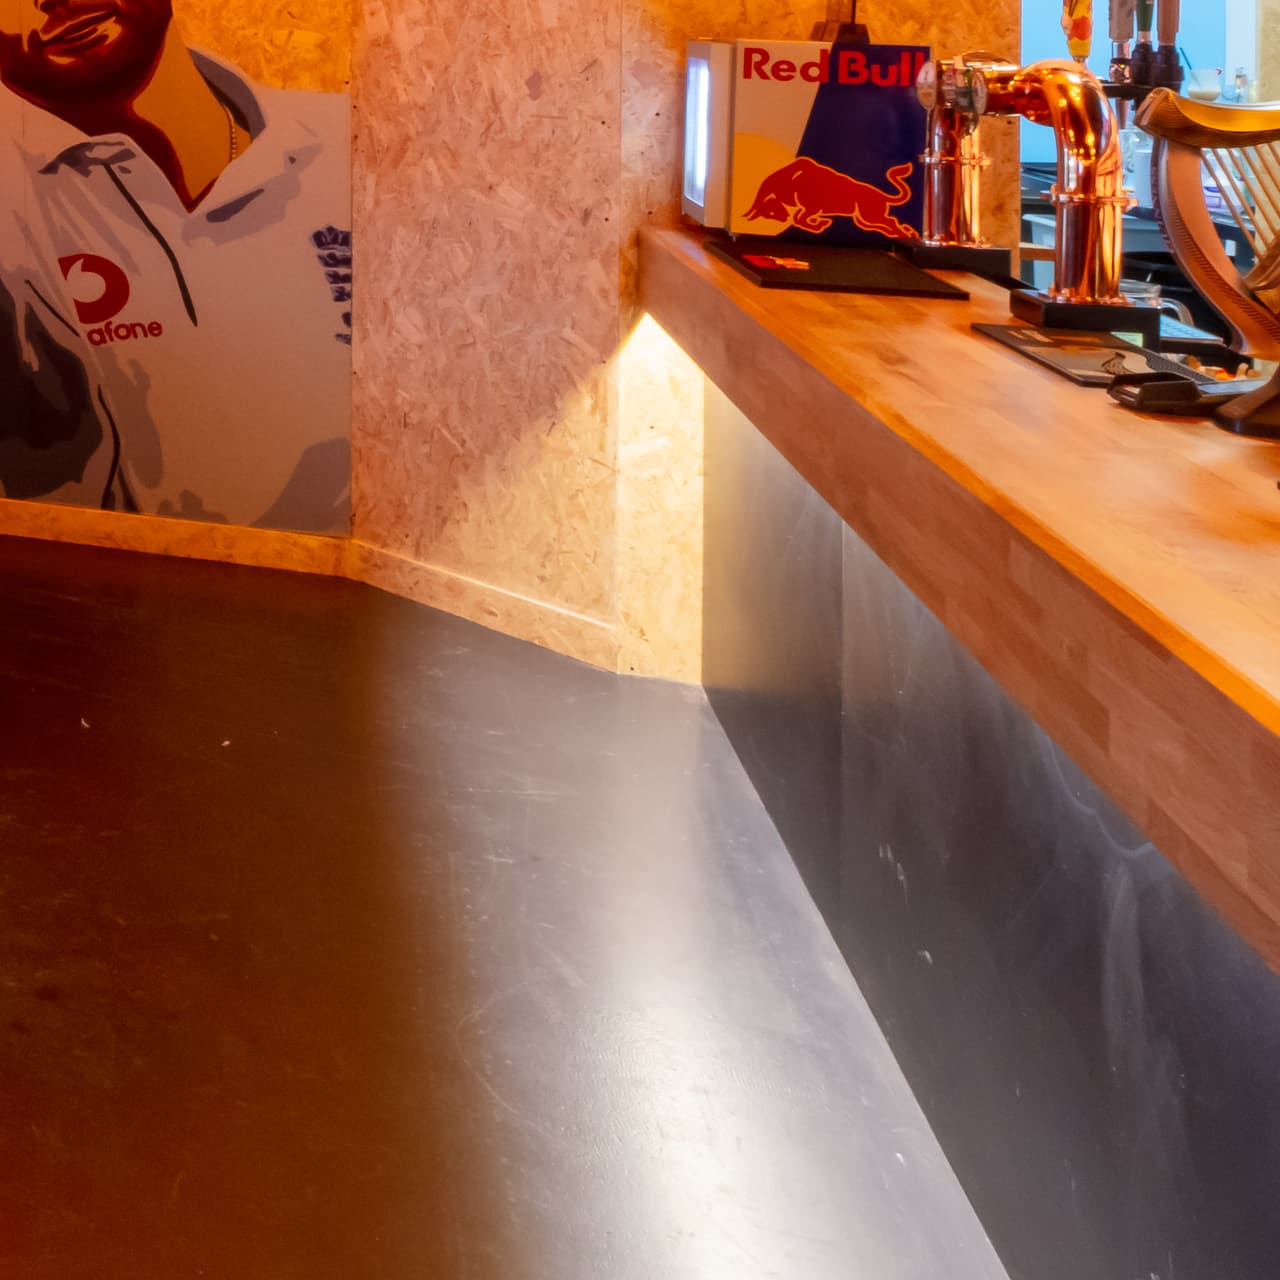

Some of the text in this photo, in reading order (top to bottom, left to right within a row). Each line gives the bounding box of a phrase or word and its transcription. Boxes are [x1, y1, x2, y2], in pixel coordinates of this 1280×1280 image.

[743, 47, 925, 87] Red Bull
[87, 320, 163, 347] afone
